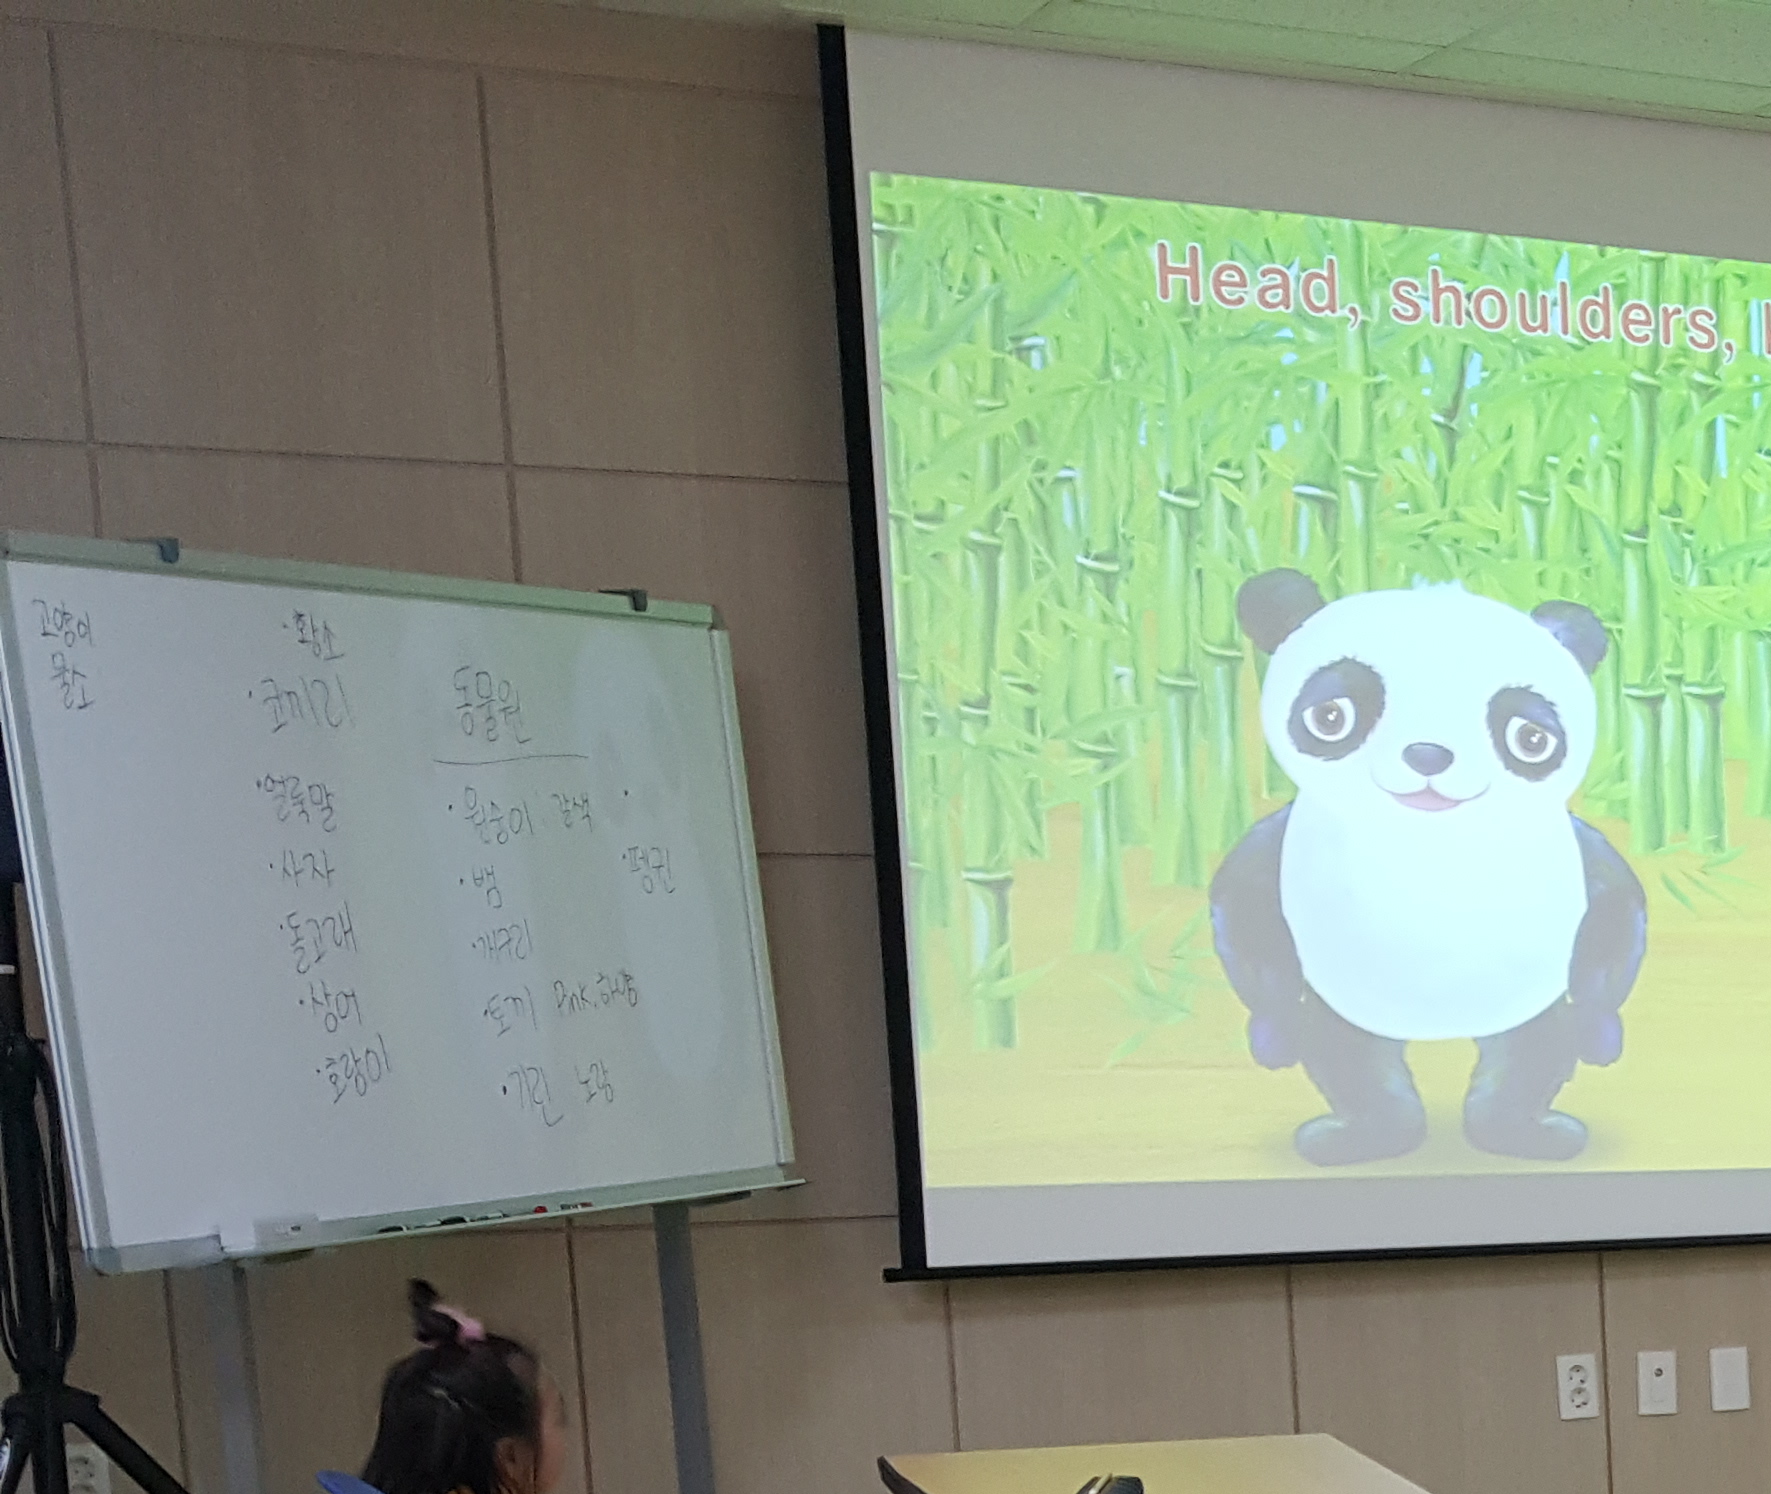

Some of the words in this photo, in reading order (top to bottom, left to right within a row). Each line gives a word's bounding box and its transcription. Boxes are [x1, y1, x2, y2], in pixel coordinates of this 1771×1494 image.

[1154, 241, 1361, 330] Head,
[1390, 265, 1736, 364] shoulders,
[32, 599, 95, 648] 고양이
[260, 664, 357, 734] 코끼리
[453, 665, 533, 745] 동물원
[263, 773, 338, 833] 얼룩말
[282, 849, 337, 889] 사자
[472, 864, 503, 909] 뱀
[627, 845, 677, 895] 펭귄
[286, 900, 358, 976] 돌고래
[475, 918, 534, 961] 개구리
[308, 977, 363, 1033] 상어
[487, 984, 538, 1038] 토끼
[325, 1032, 393, 1105] 호랑이
[507, 1063, 565, 1128] 기린
